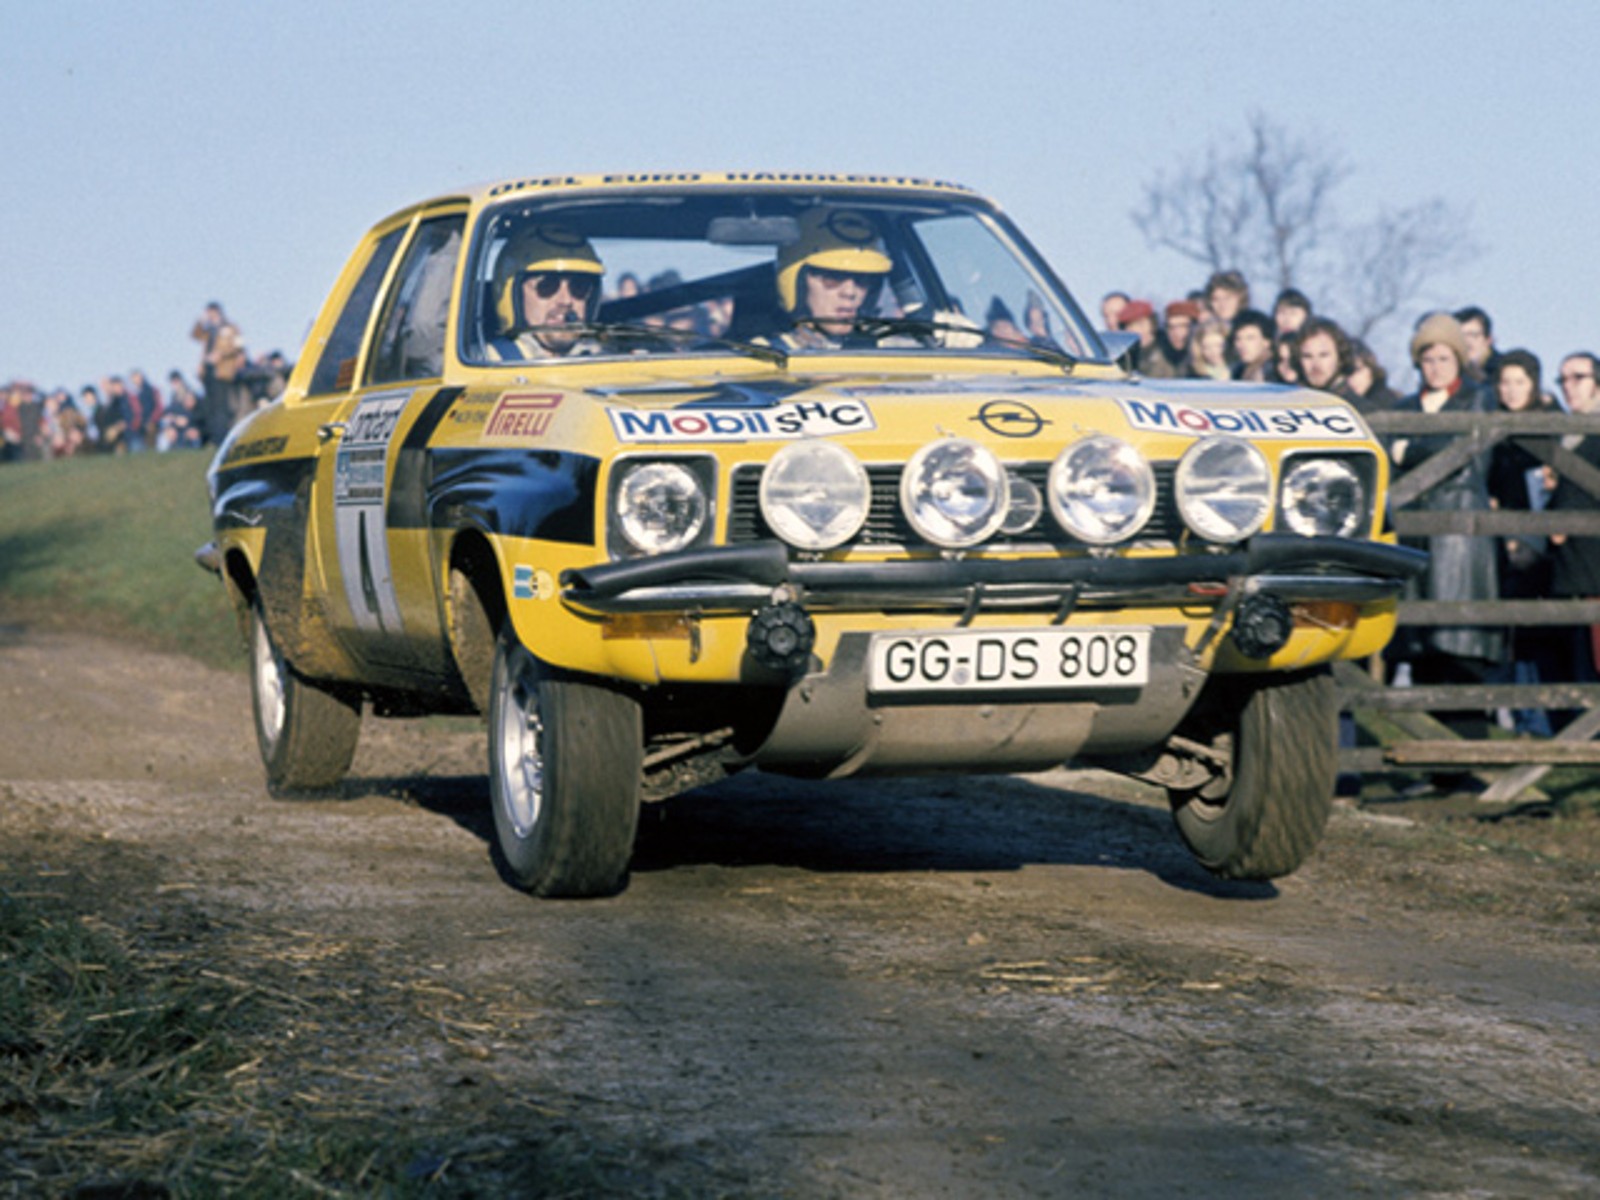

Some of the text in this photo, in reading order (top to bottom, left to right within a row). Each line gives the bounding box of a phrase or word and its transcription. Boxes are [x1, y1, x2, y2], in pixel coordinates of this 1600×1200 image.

[489, 176, 582, 196] OPEL
[603, 172, 701, 184] EURO
[486, 393, 564, 436] PIRELLI
[619, 401, 864, 435] Mobil SHC
[1127, 400, 1355, 434] Mobil SHC
[885, 635, 1137, 682] GG-DS 808
